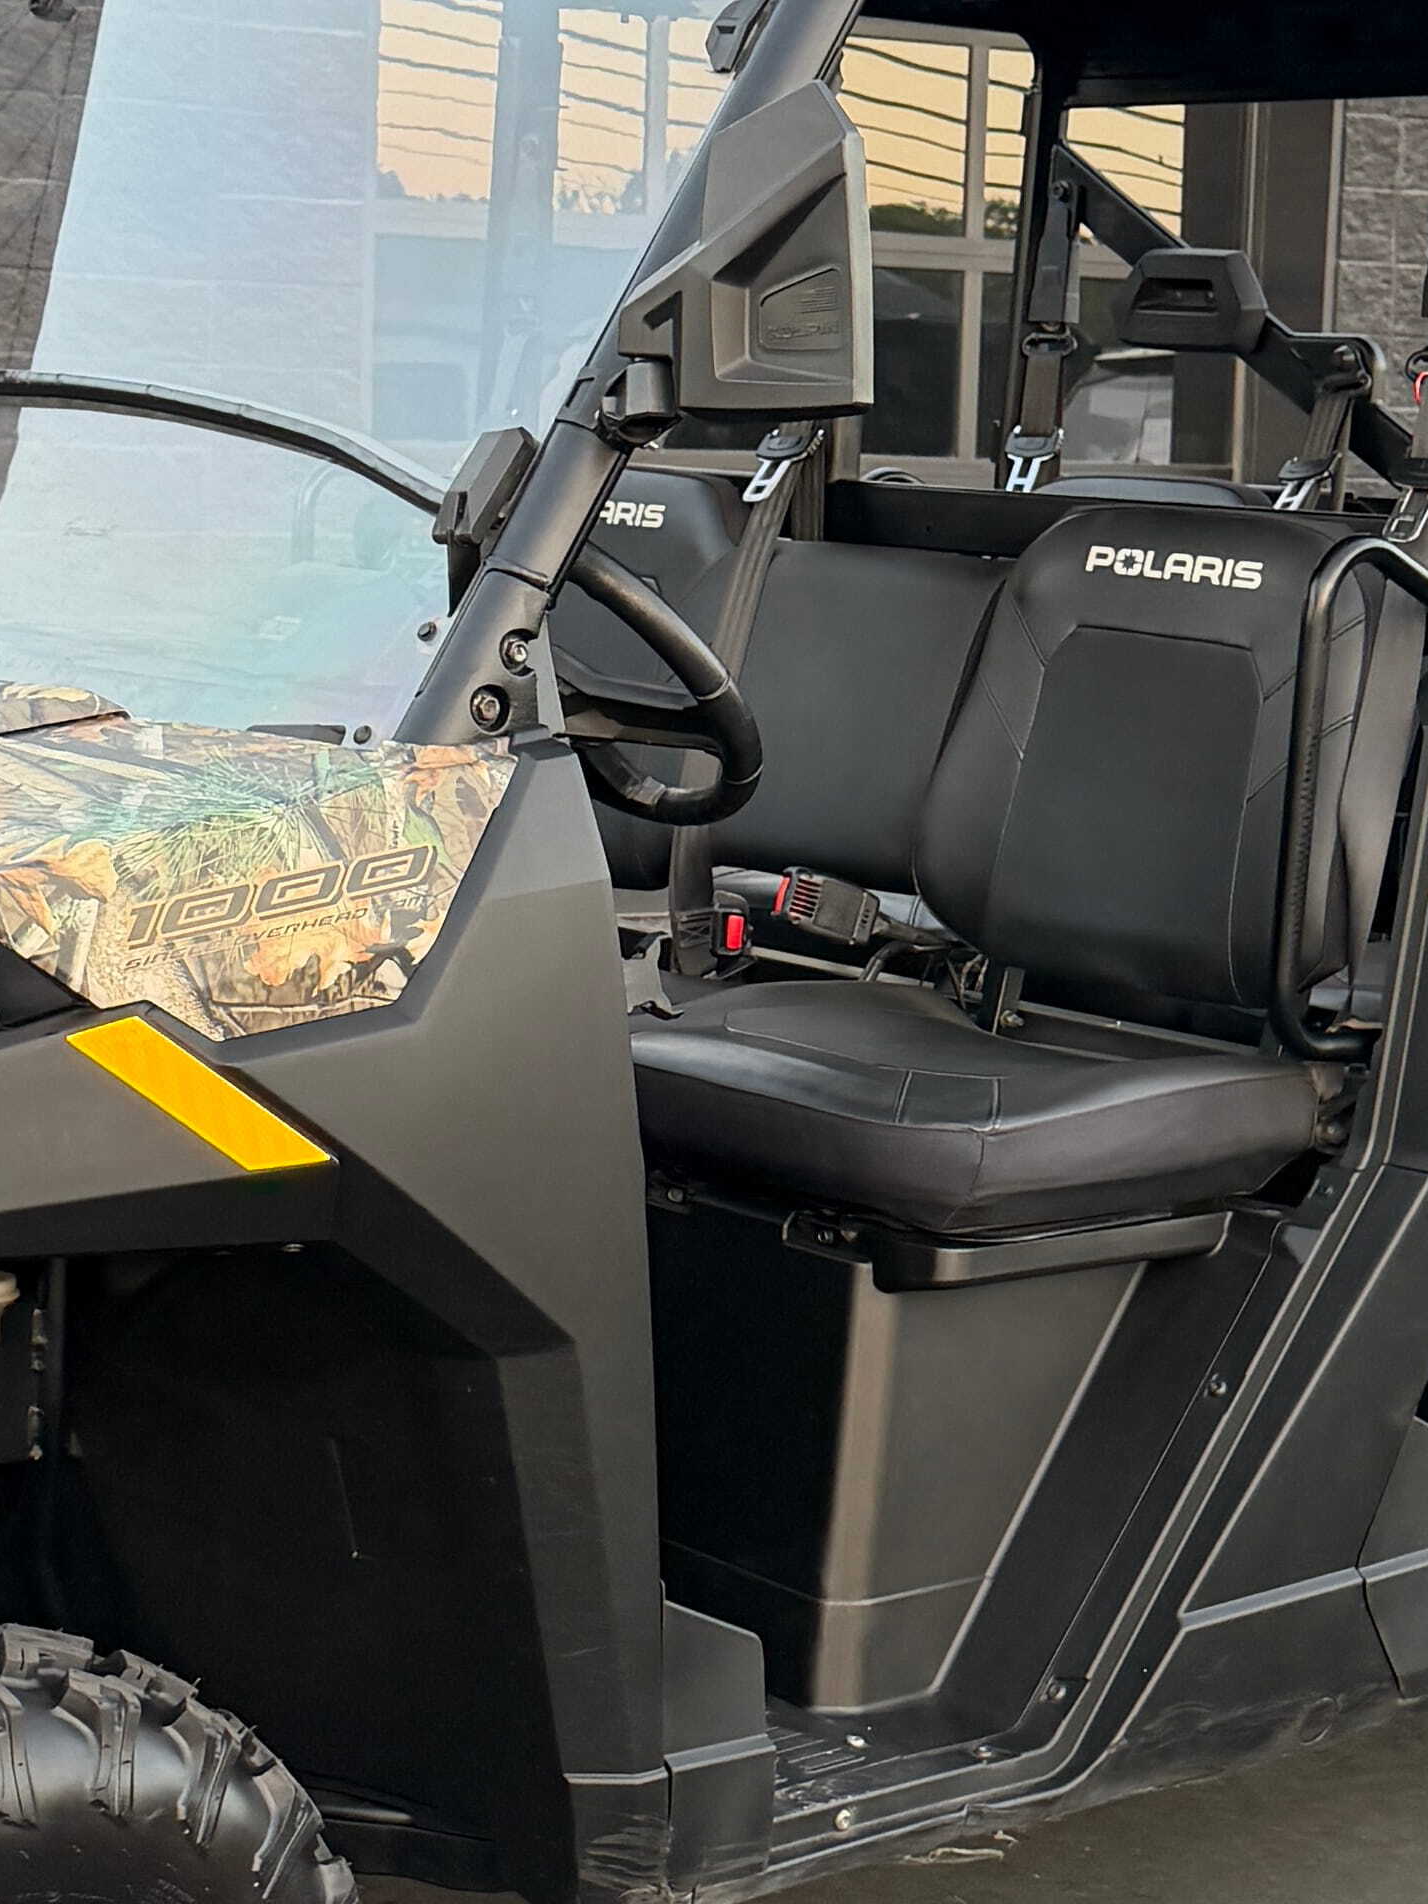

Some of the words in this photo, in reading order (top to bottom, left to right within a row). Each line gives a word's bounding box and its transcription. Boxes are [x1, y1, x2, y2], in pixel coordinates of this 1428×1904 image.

[599, 500, 667, 528] ARIS
[1084, 545, 1264, 590] POLARIS
[126, 844, 439, 950] 1000
